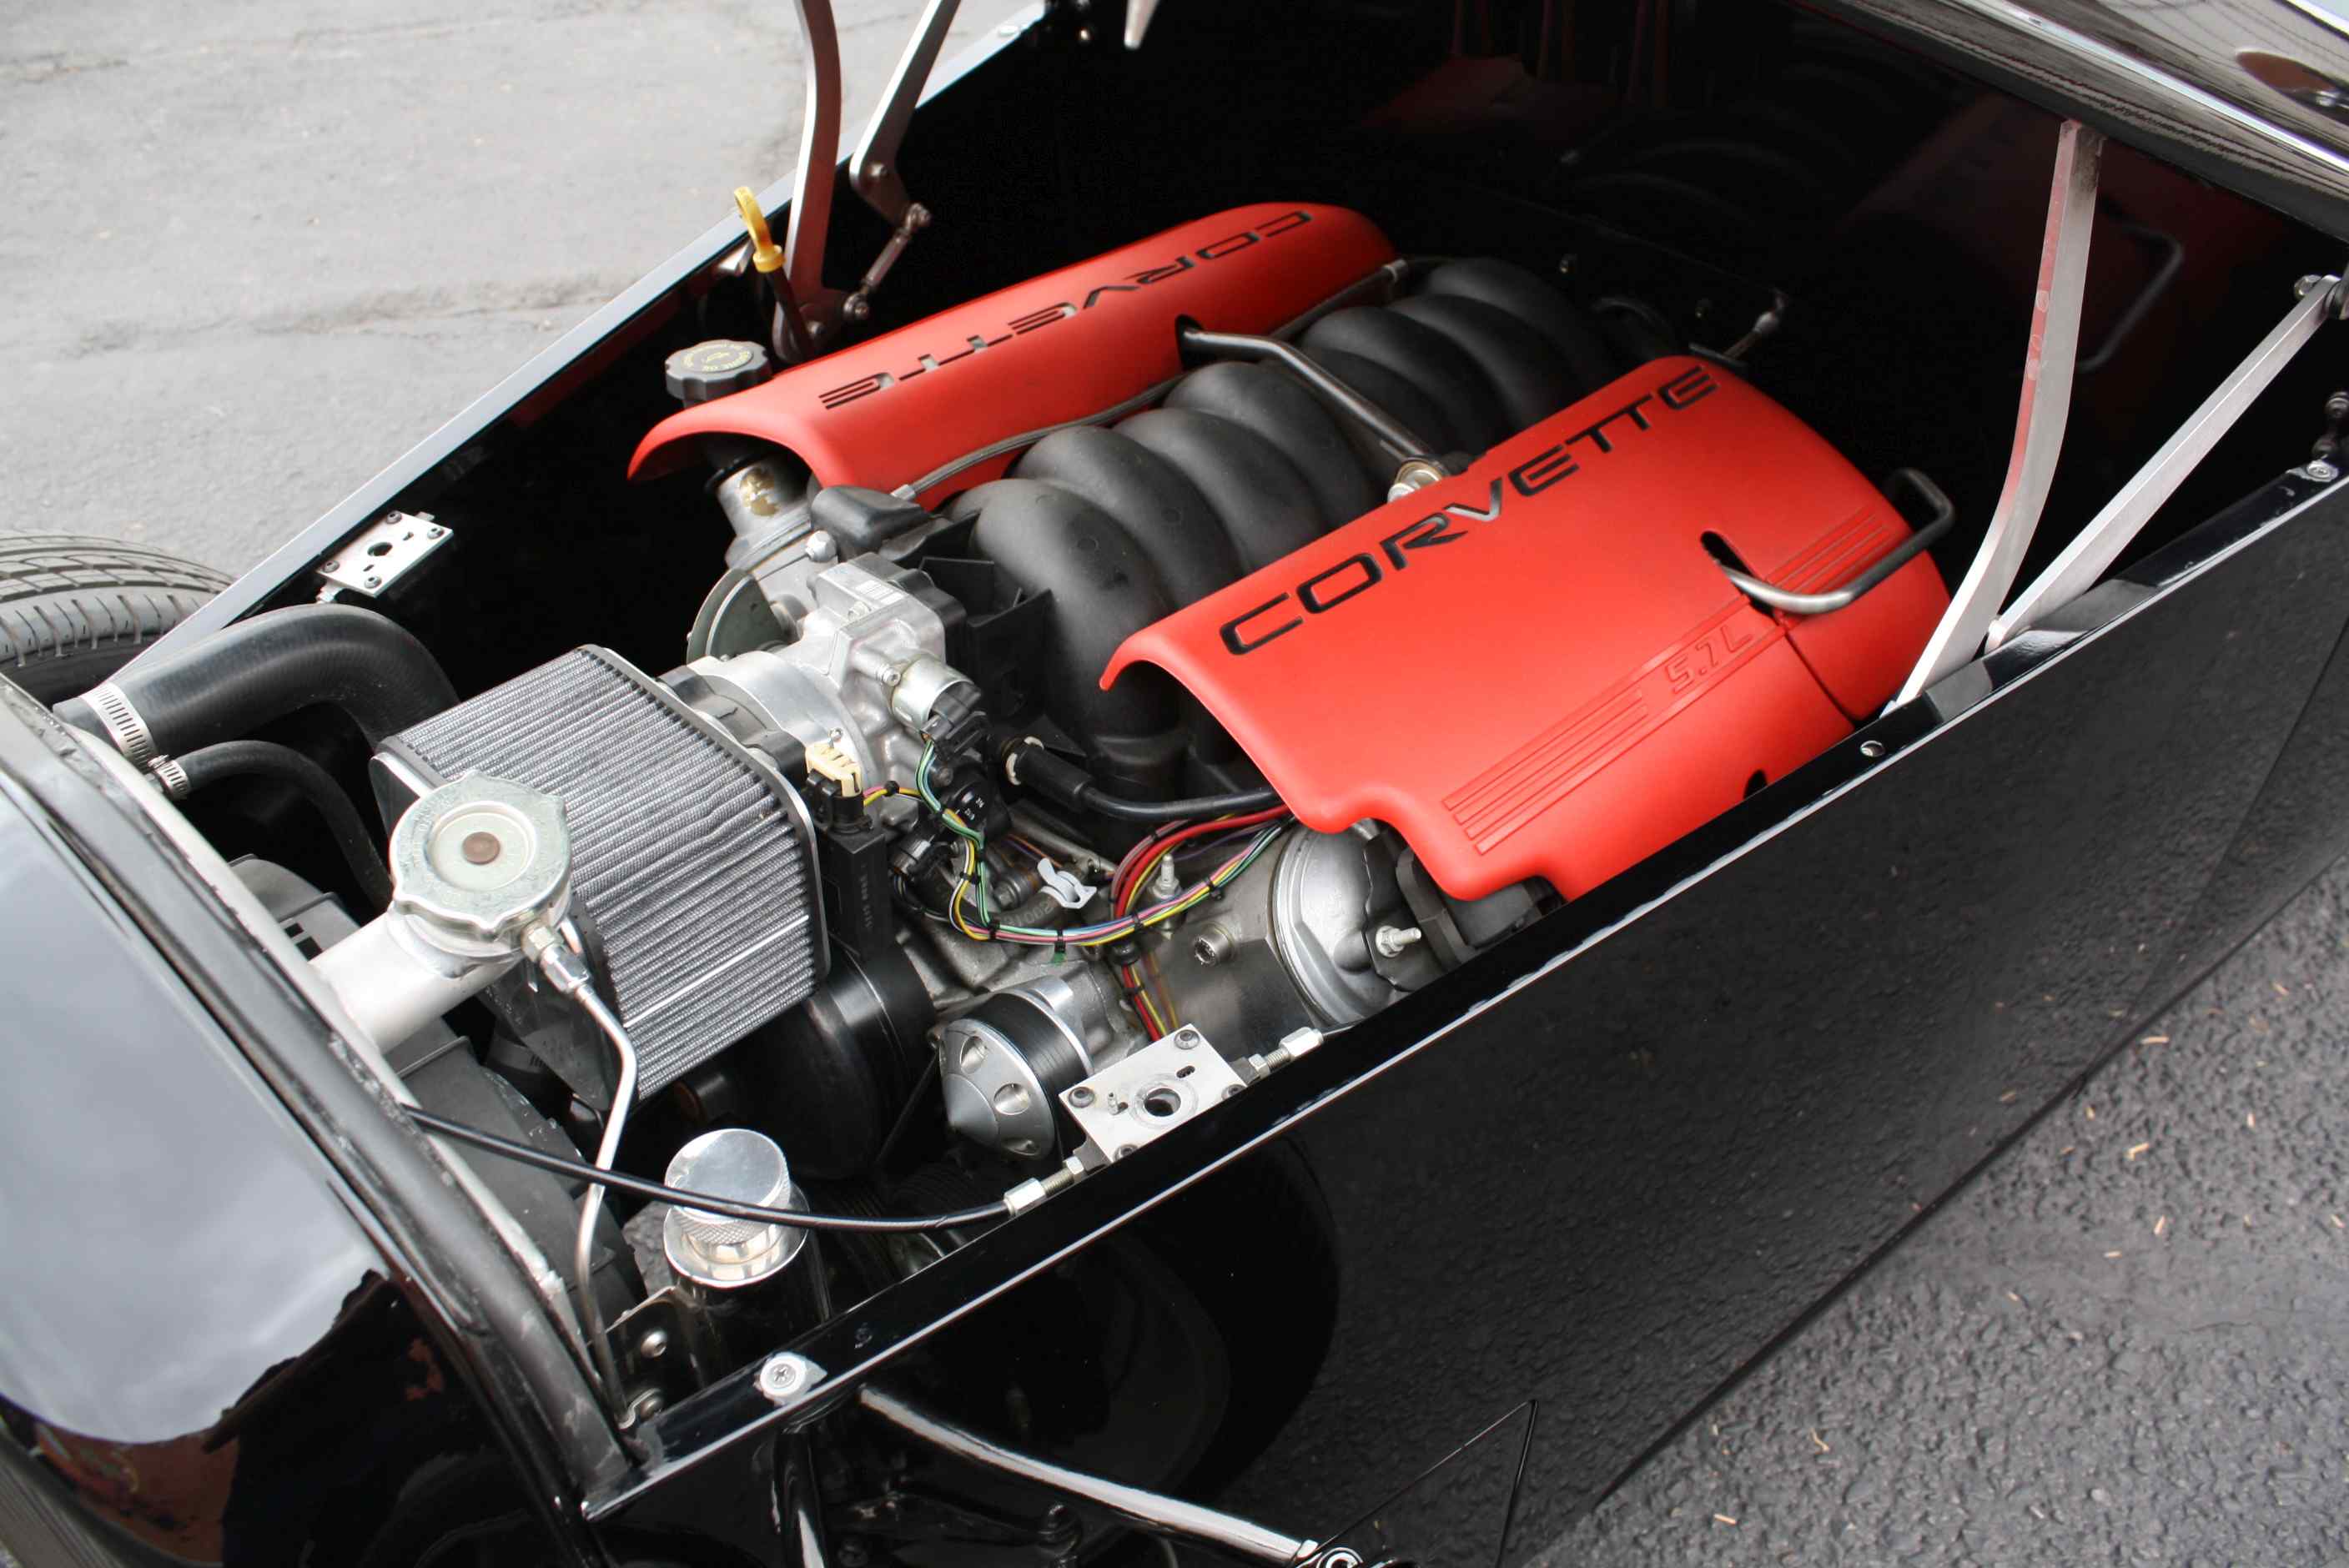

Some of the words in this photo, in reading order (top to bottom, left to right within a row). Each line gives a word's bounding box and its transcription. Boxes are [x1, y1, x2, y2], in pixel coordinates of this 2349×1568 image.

[818, 210, 1312, 410] CORVETTE
[1219, 365, 1719, 656] CORVETTE
[1664, 624, 1753, 695] 5.7L
